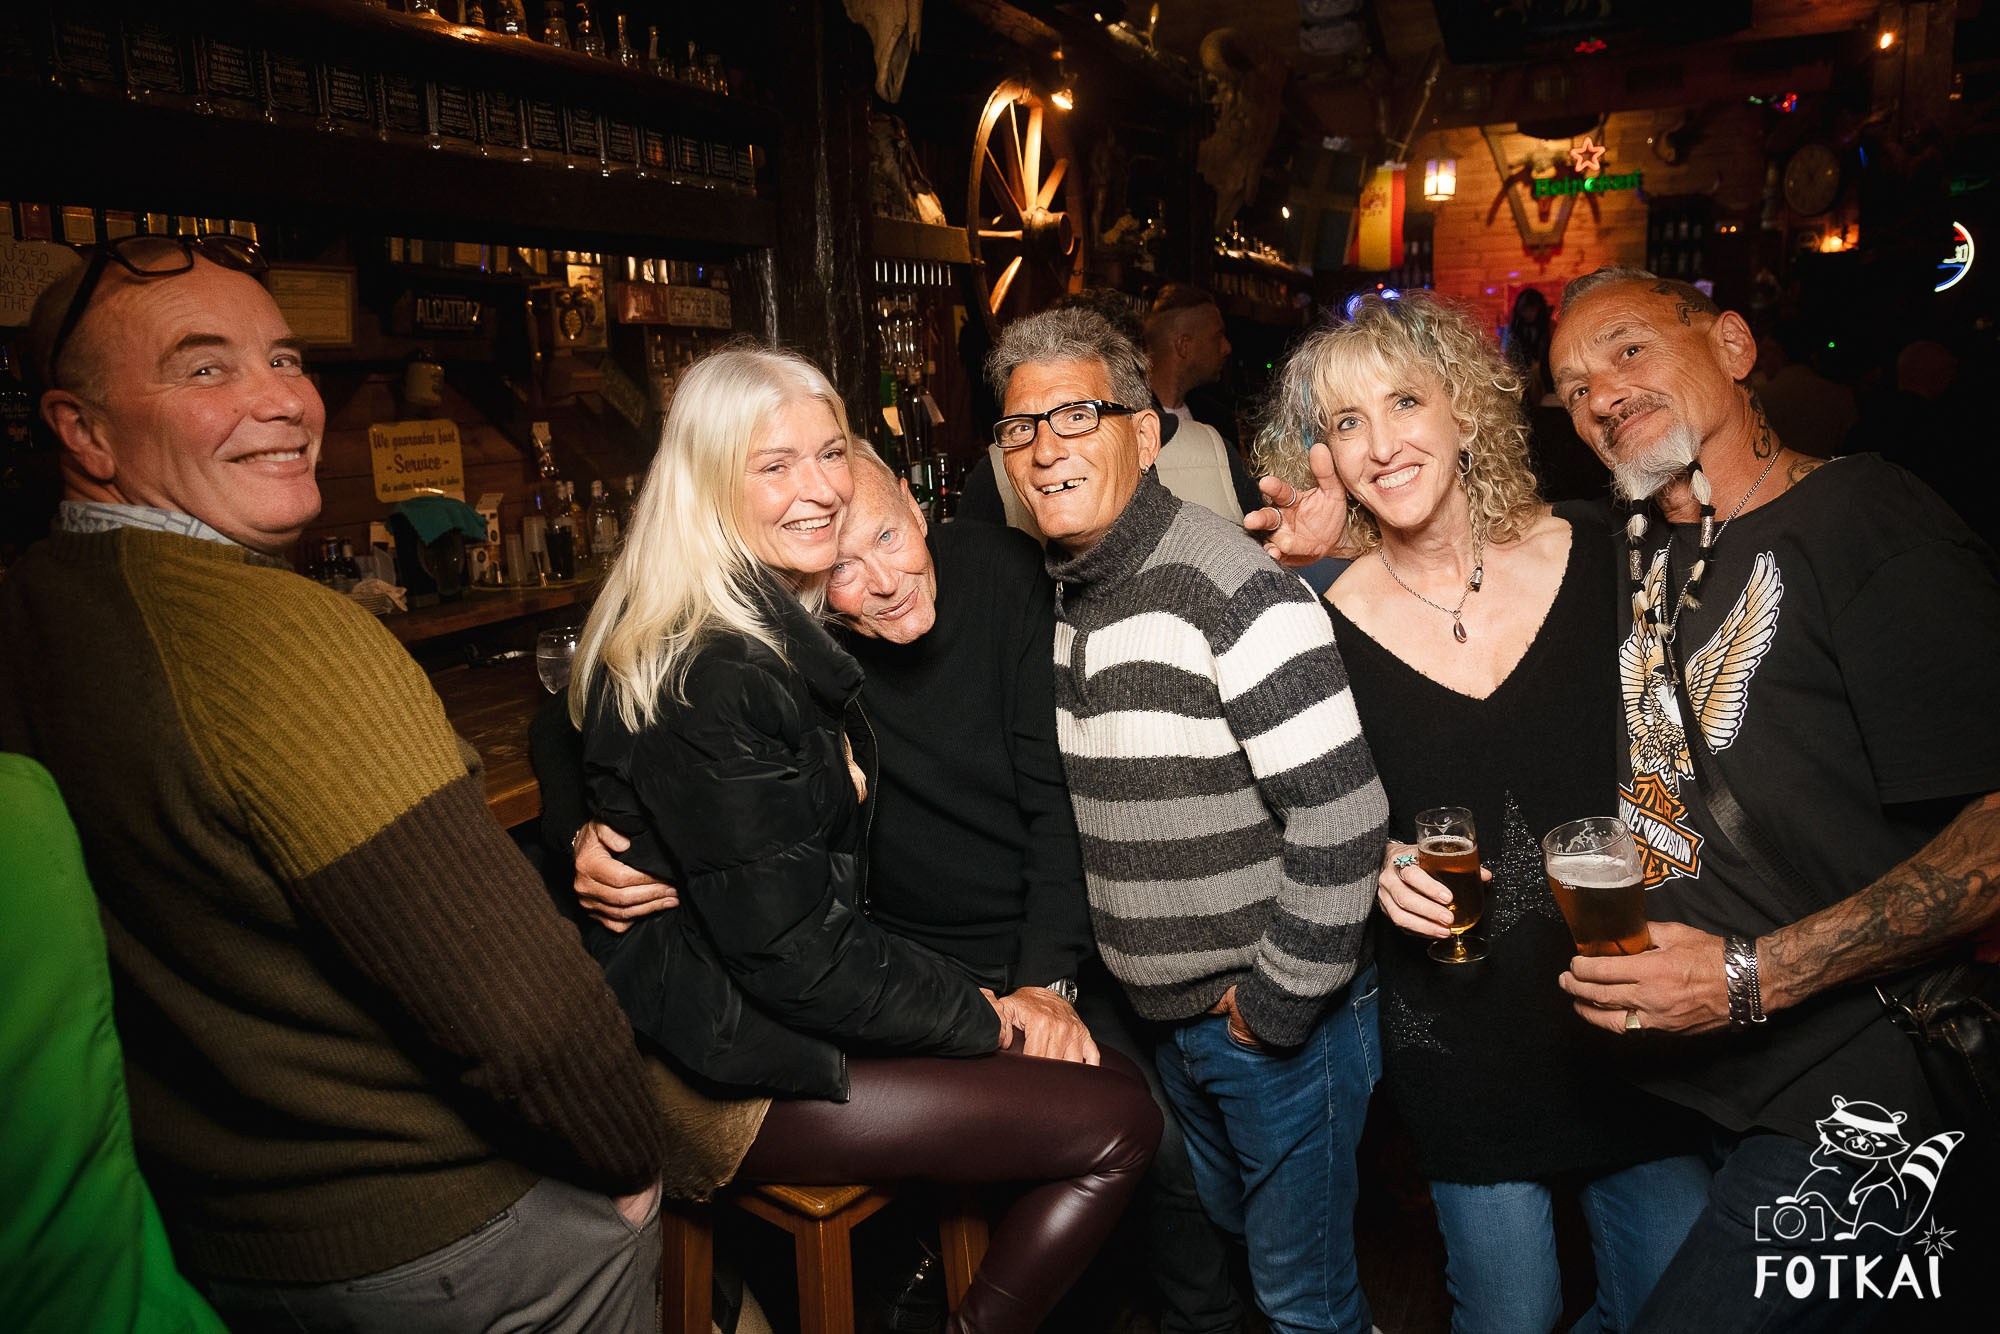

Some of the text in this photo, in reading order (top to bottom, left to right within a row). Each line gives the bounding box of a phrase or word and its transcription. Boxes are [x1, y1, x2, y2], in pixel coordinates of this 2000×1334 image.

[416, 297, 481, 325] ALCATRAZ
[372, 431, 390, 450] We
[393, 453, 442, 474] Service
